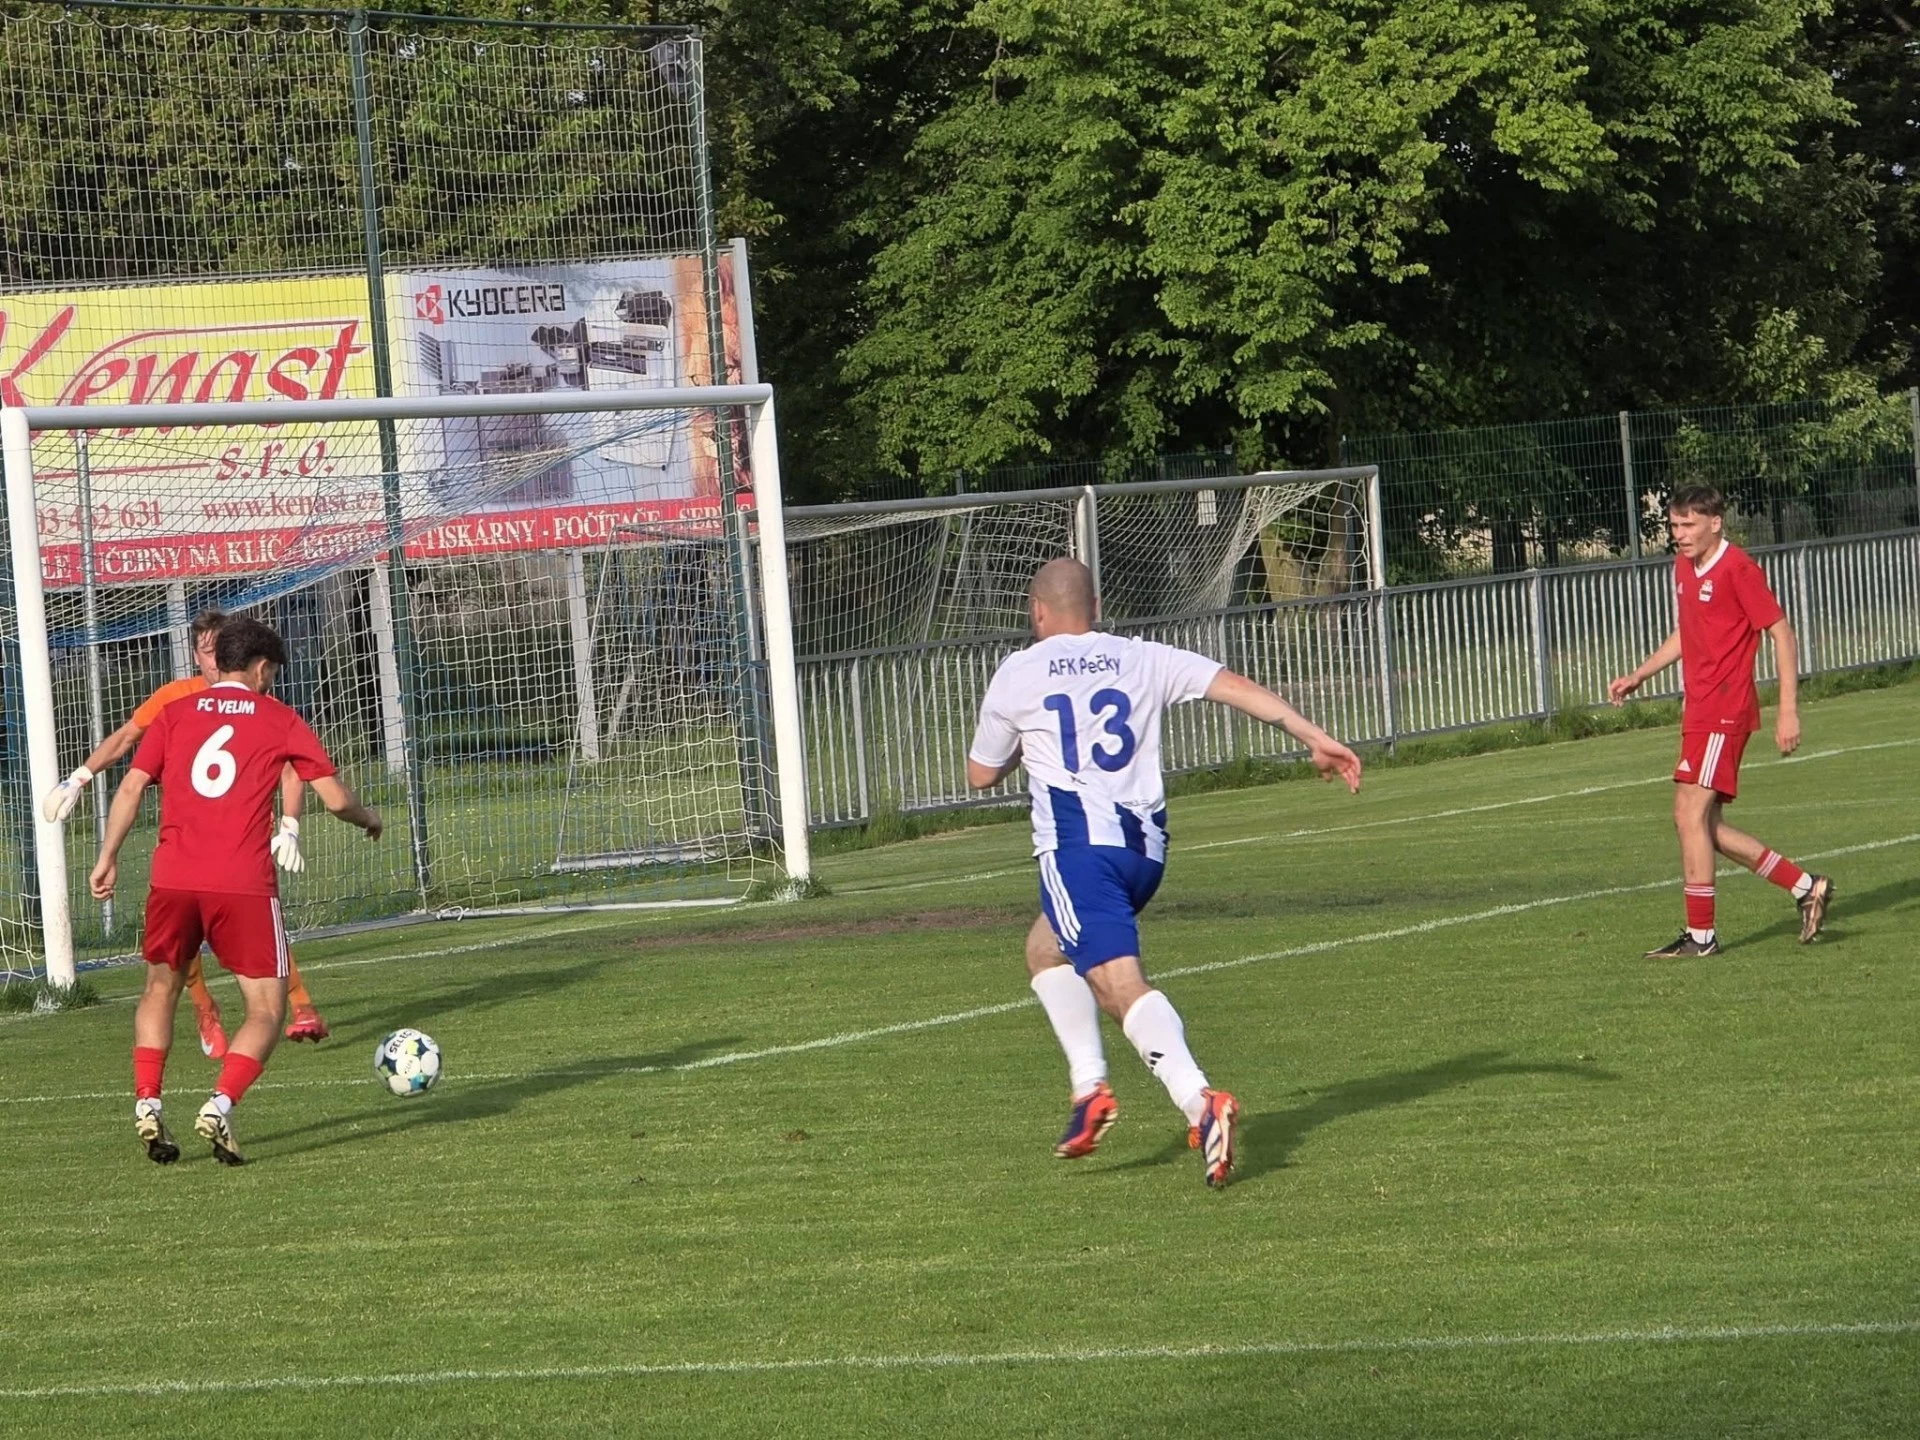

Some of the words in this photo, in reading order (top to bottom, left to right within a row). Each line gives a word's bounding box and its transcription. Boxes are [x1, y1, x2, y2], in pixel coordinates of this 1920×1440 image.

[448, 284, 566, 318] KYOCERA
[216, 440, 334, 481] s.r.o.
[121, 500, 163, 528] 631
[425, 516, 536, 550] TISKÁRNY
[554, 508, 662, 540] POČÍTAČE
[189, 543, 221, 568] NA
[226, 533, 282, 565] KLÍČ
[1048, 658, 1077, 677] AFK
[196, 697, 215, 712] FC
[217, 698, 255, 715] VELIM
[1043, 687, 1136, 775] 13
[190, 724, 237, 799] 6
